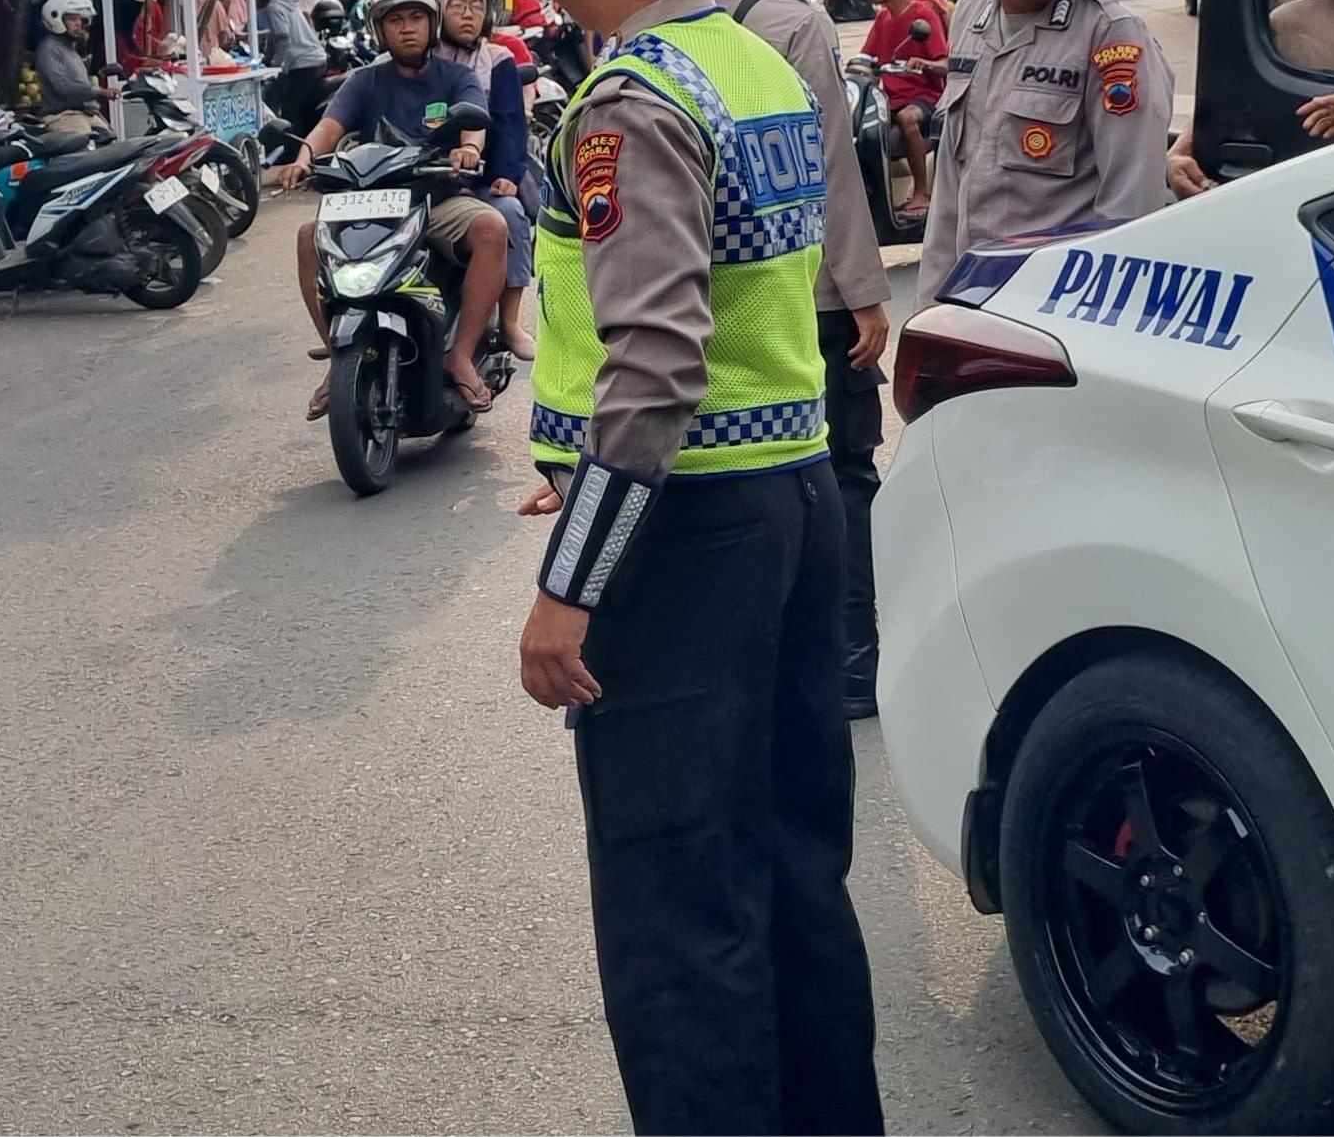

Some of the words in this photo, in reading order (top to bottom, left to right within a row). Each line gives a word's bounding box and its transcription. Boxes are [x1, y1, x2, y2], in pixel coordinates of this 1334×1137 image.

[1021, 64, 1080, 88] POLRI
[324, 195, 333, 207] K
[380, 191, 407, 203] ATC
[1037, 248, 1255, 351] PATWAL
